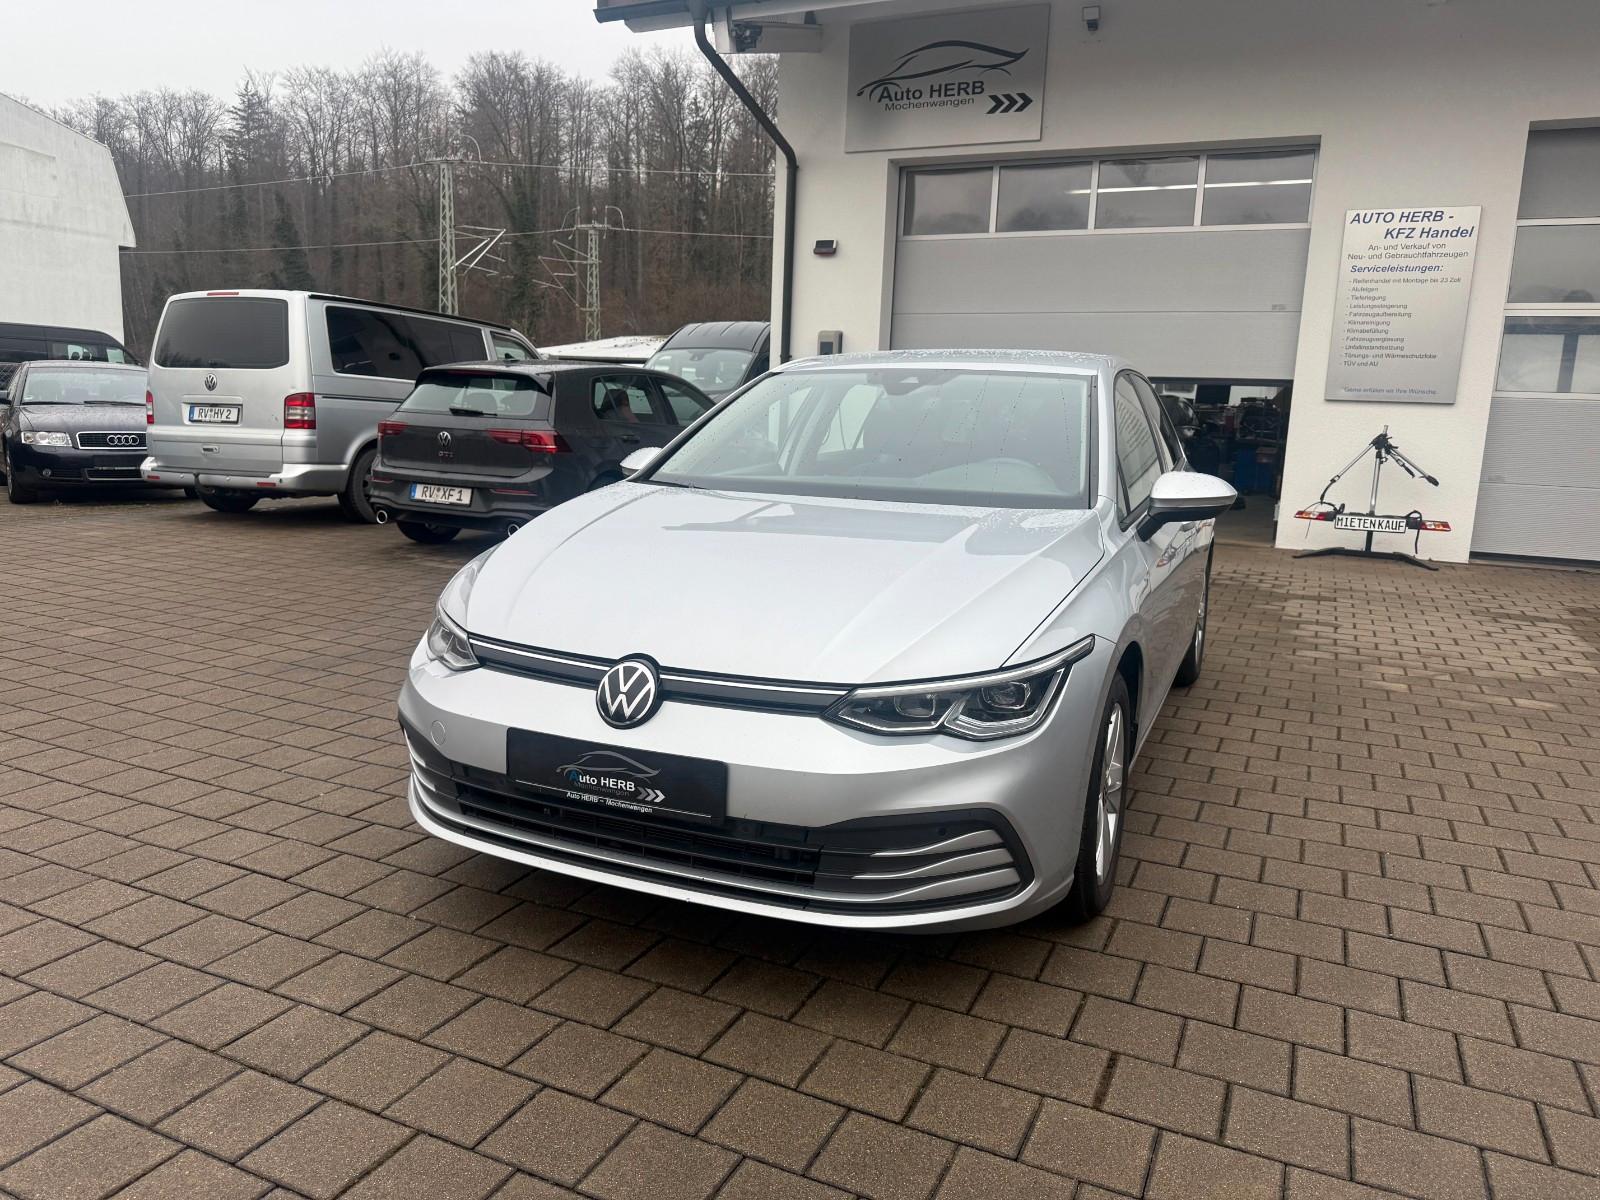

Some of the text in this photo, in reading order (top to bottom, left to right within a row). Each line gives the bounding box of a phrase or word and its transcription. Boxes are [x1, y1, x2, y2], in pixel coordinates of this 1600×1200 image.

[877, 80, 985, 103] Auto HERB
[884, 97, 975, 112] Mochenwangen
[1350, 211, 1395, 224] AUTO
[1398, 210, 1445, 223] HERB
[1383, 226, 1475, 239] KFZ Handel
[1384, 250, 1469, 259] Gebrauchtfahrzeugen
[1350, 264, 1444, 274] Serviceleistungen:
[198, 407, 209, 419] RV
[226, 409, 232, 420] 2
[421, 486, 463, 502] RV XF 1
[569, 770, 636, 791] Auto HERB
[566, 791, 581, 799] Auto
[581, 793, 599, 803] HERB
